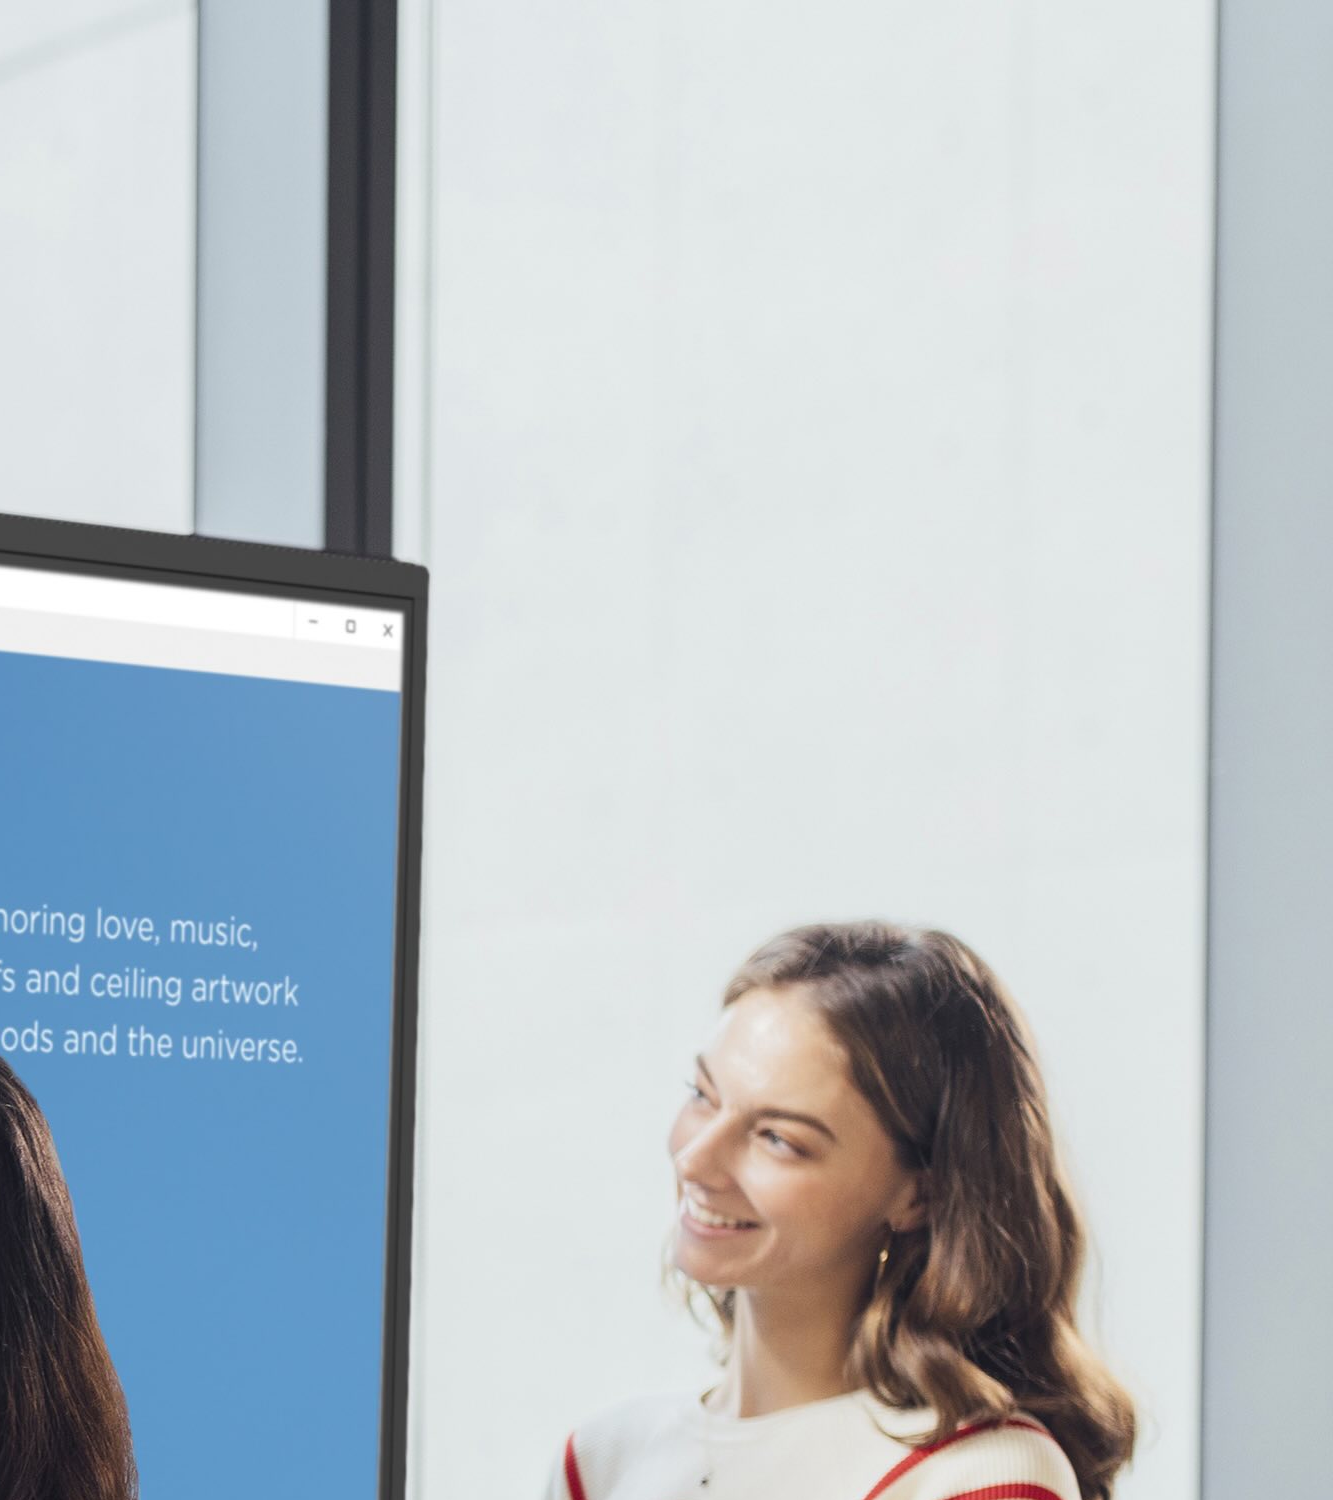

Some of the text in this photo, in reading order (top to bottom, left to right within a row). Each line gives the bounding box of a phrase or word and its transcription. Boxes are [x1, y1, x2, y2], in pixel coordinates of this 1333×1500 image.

[96, 906, 161, 946] love,
[169, 915, 258, 952] music,
[25, 964, 81, 997] and
[89, 967, 183, 1007] ceiling
[190, 975, 299, 1007] artwork
[62, 1023, 118, 1057] and
[126, 1024, 174, 1059] the
[181, 1029, 304, 1064] universe.
